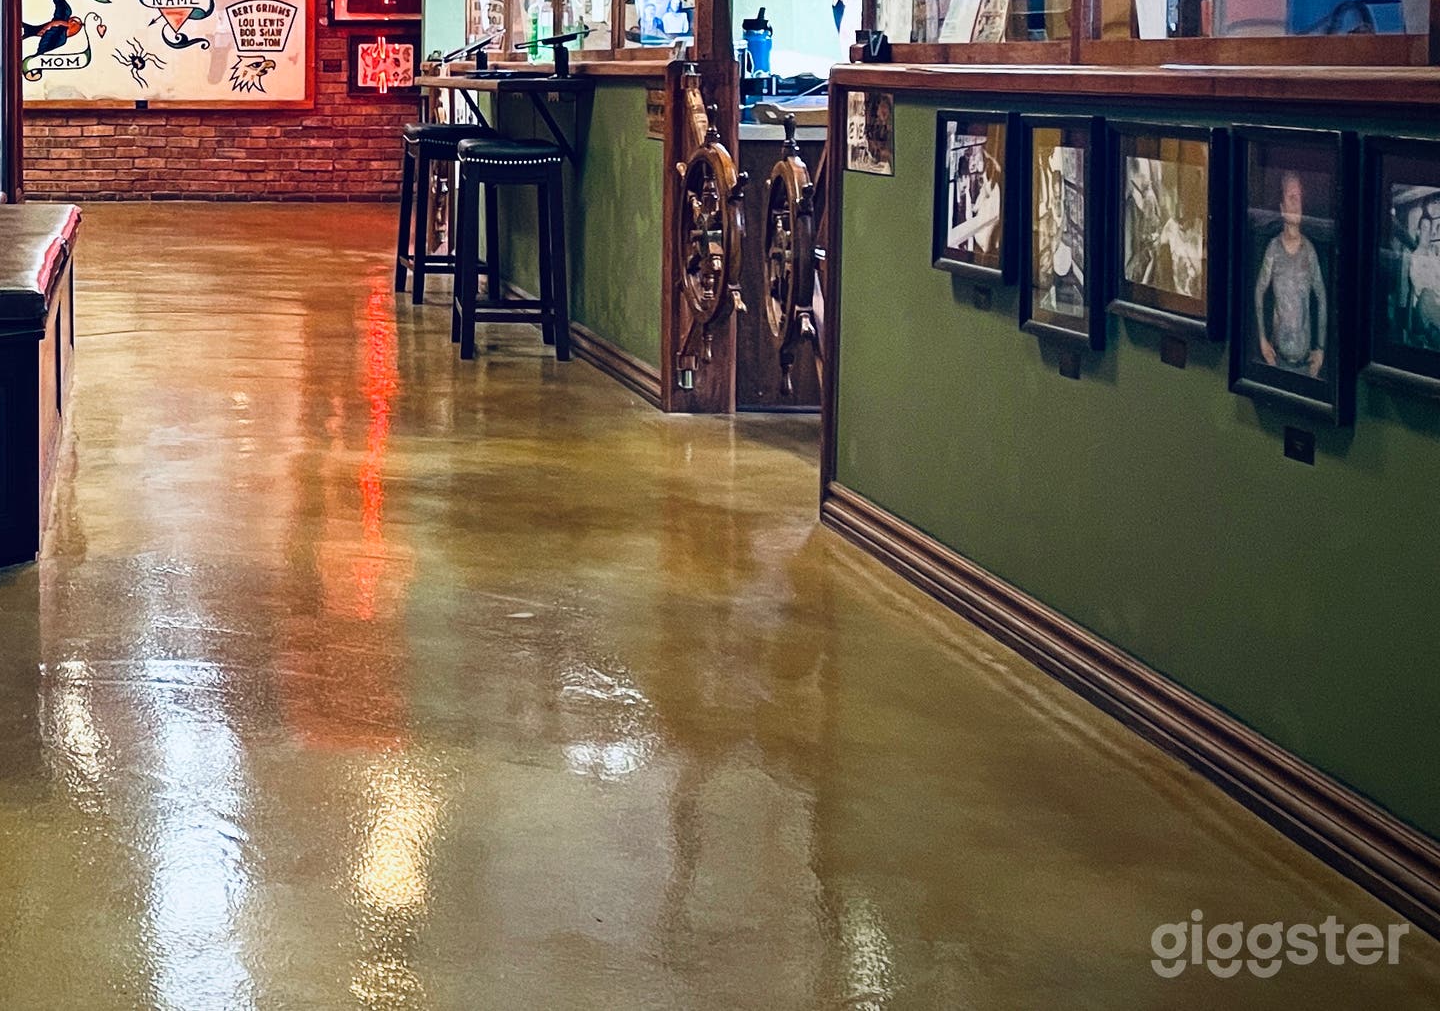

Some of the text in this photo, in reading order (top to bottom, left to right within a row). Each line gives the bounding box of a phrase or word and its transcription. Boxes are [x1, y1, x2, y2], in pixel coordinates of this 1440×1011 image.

[231, 3, 292, 18] BERT GRIMMS
[238, 18, 285, 28] LOU LEWIS
[240, 28, 256, 37] BOB
[263, 38, 281, 47] TOM
[40, 56, 80, 67] MOM
